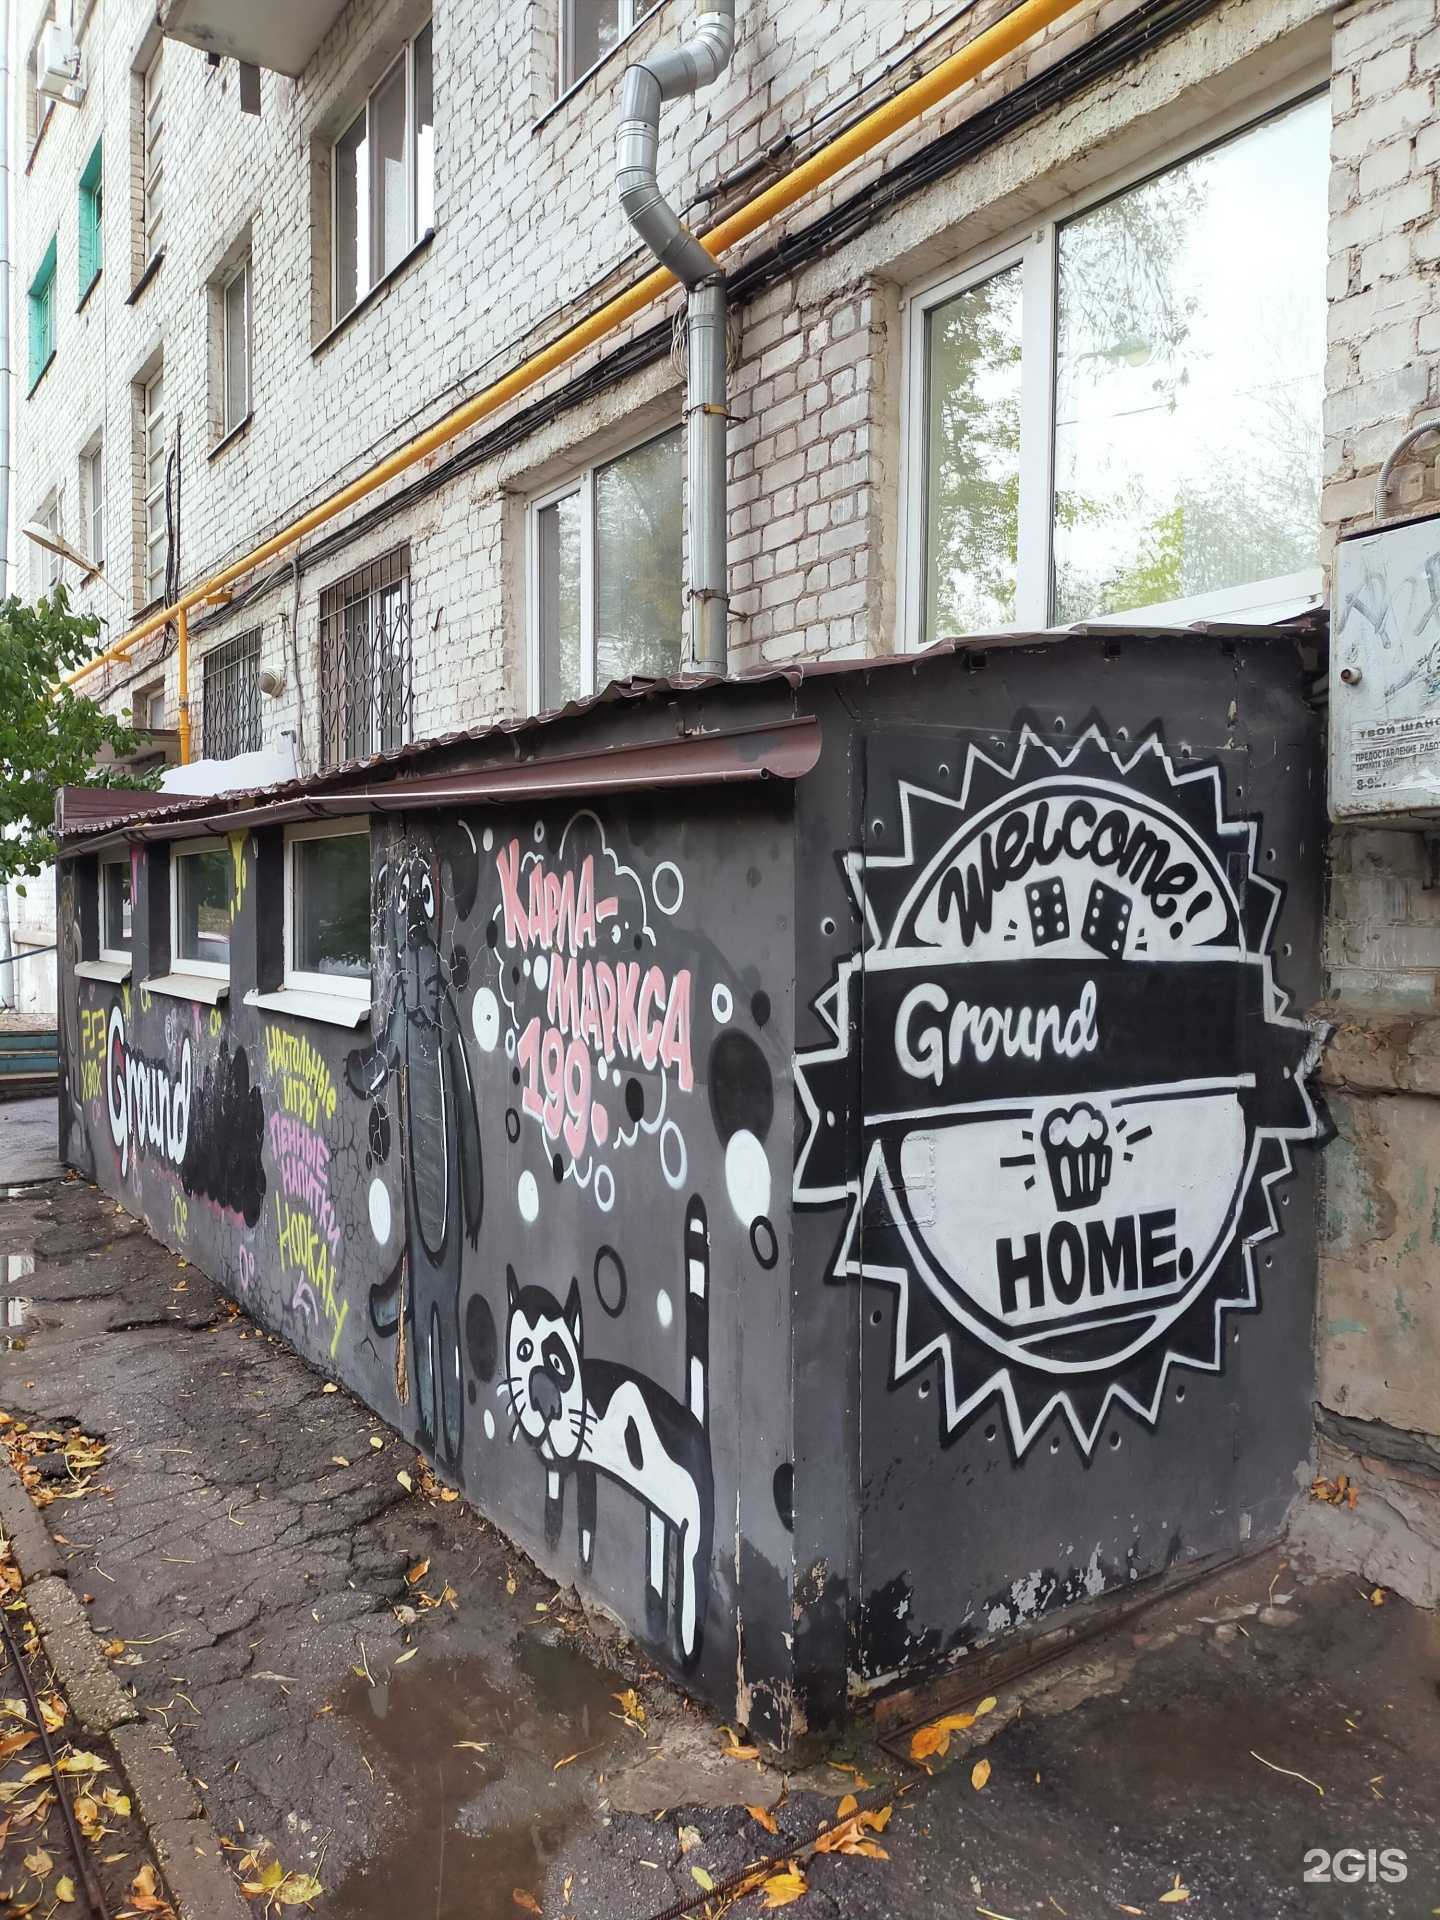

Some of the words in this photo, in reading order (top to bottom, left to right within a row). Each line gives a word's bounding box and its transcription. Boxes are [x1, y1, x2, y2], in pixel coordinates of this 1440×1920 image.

[1355, 743, 1417, 763] ПРЕДОСТАВЛЕНИЕ
[1359, 723, 1396, 739] ТВОЙ
[938, 800, 1213, 947] Welcome!
[547, 951, 694, 1093] МАРКСА
[896, 979, 1099, 1087] Ground
[269, 1111, 330, 1185] ПЕННЫЕ
[282, 1074, 319, 1130] ИГРЫ
[281, 1155, 341, 1258] НАПИТКИ
[995, 1208, 1194, 1317] HOME.
